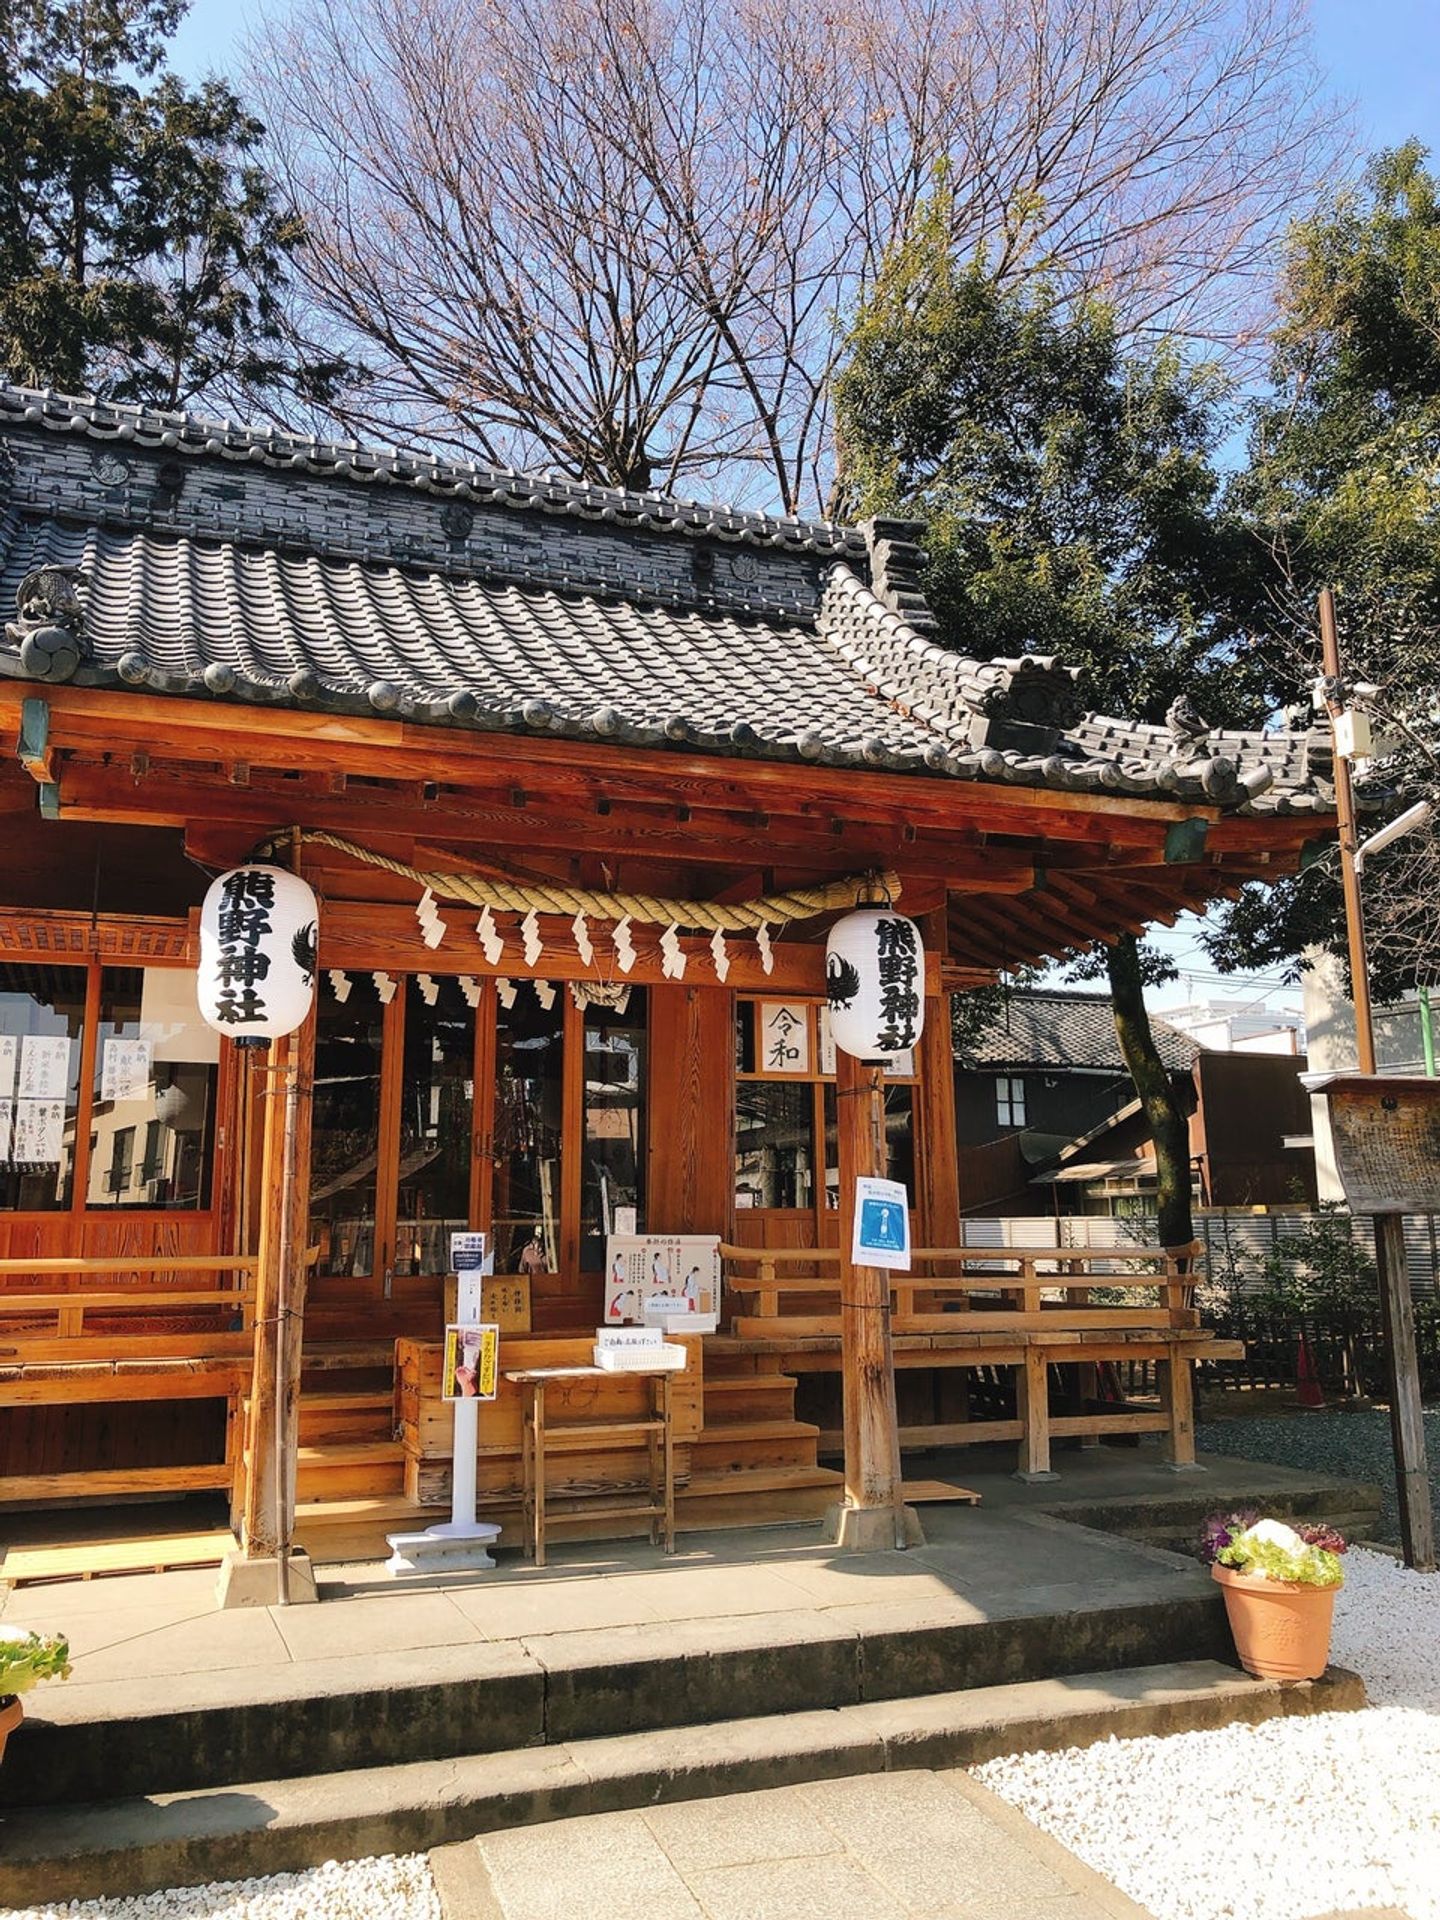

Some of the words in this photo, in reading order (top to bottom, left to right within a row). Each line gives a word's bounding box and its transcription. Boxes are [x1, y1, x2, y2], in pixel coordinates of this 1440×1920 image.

[216, 870, 276, 1024] 熊野神社
[873, 918, 919, 1052] 熊野神社
[767, 1007, 803, 1068] 令和
